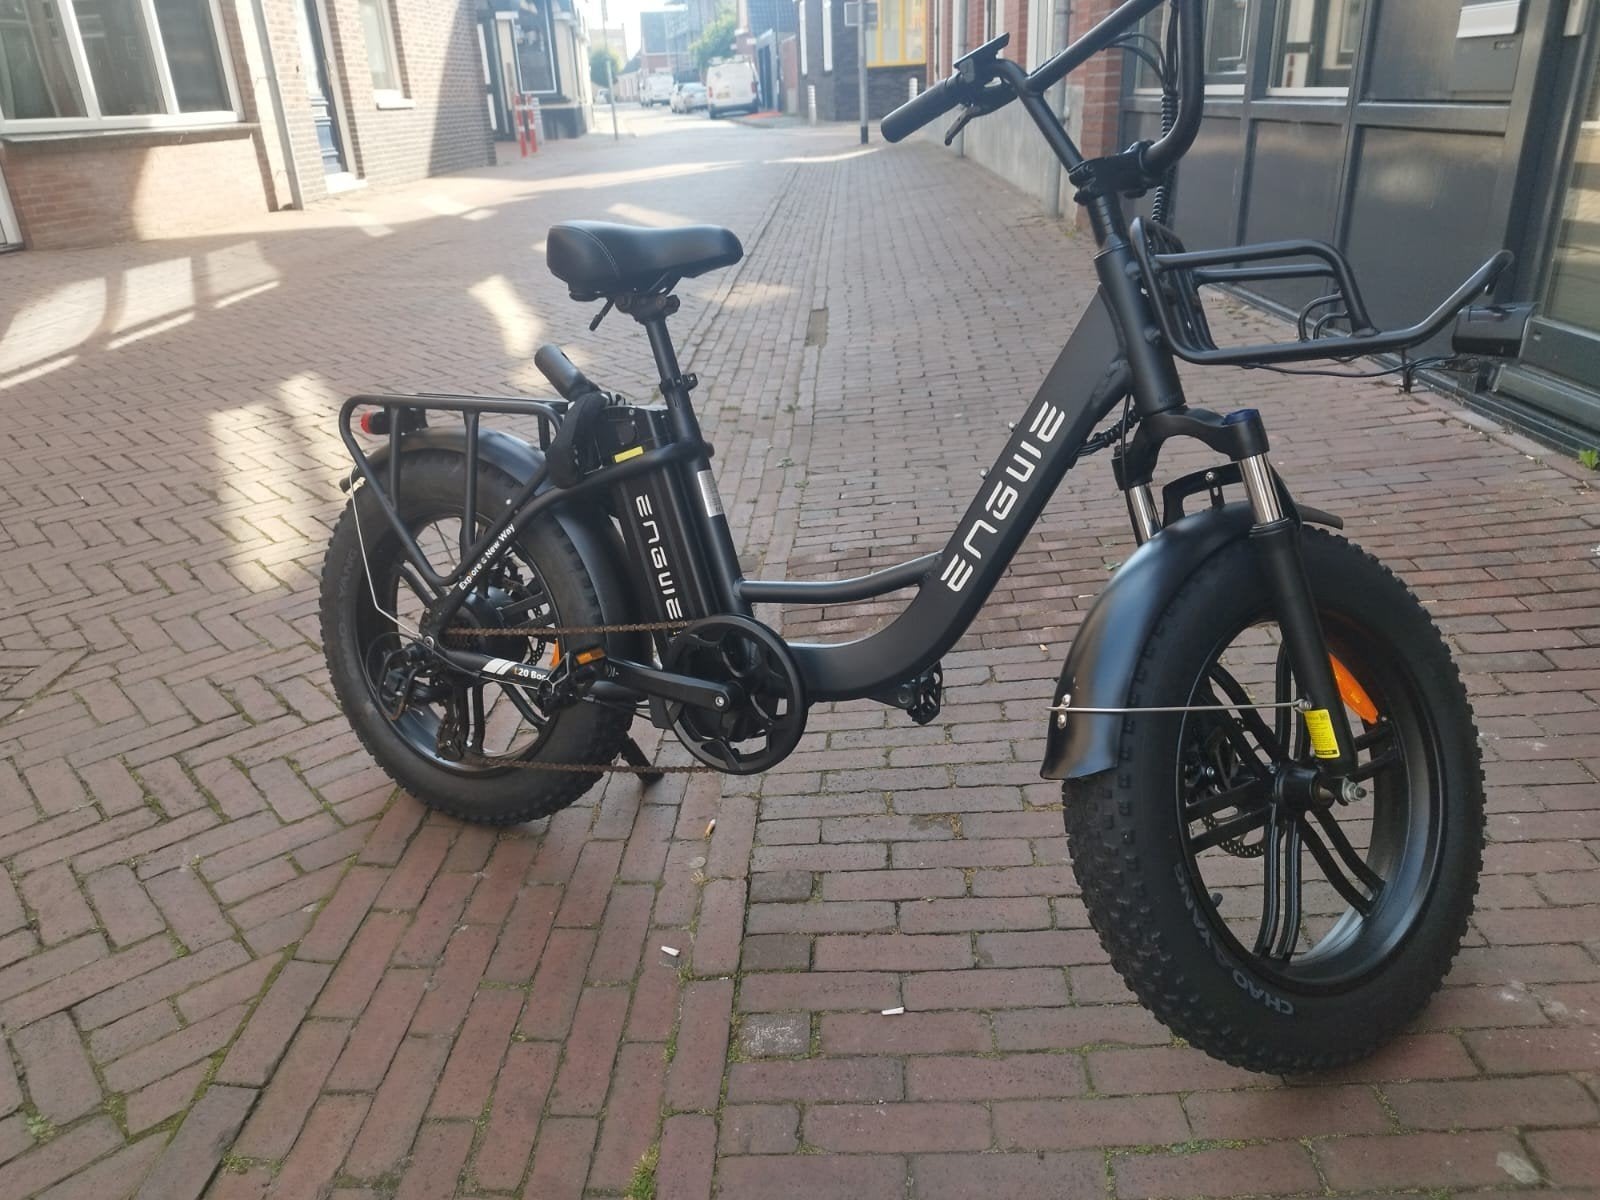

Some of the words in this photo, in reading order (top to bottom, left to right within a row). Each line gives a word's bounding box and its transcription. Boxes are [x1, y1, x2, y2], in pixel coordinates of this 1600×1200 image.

[485, 541, 500, 559] New
[498, 523, 516, 542] Way
[1232, 968, 1295, 1016] CHAO
